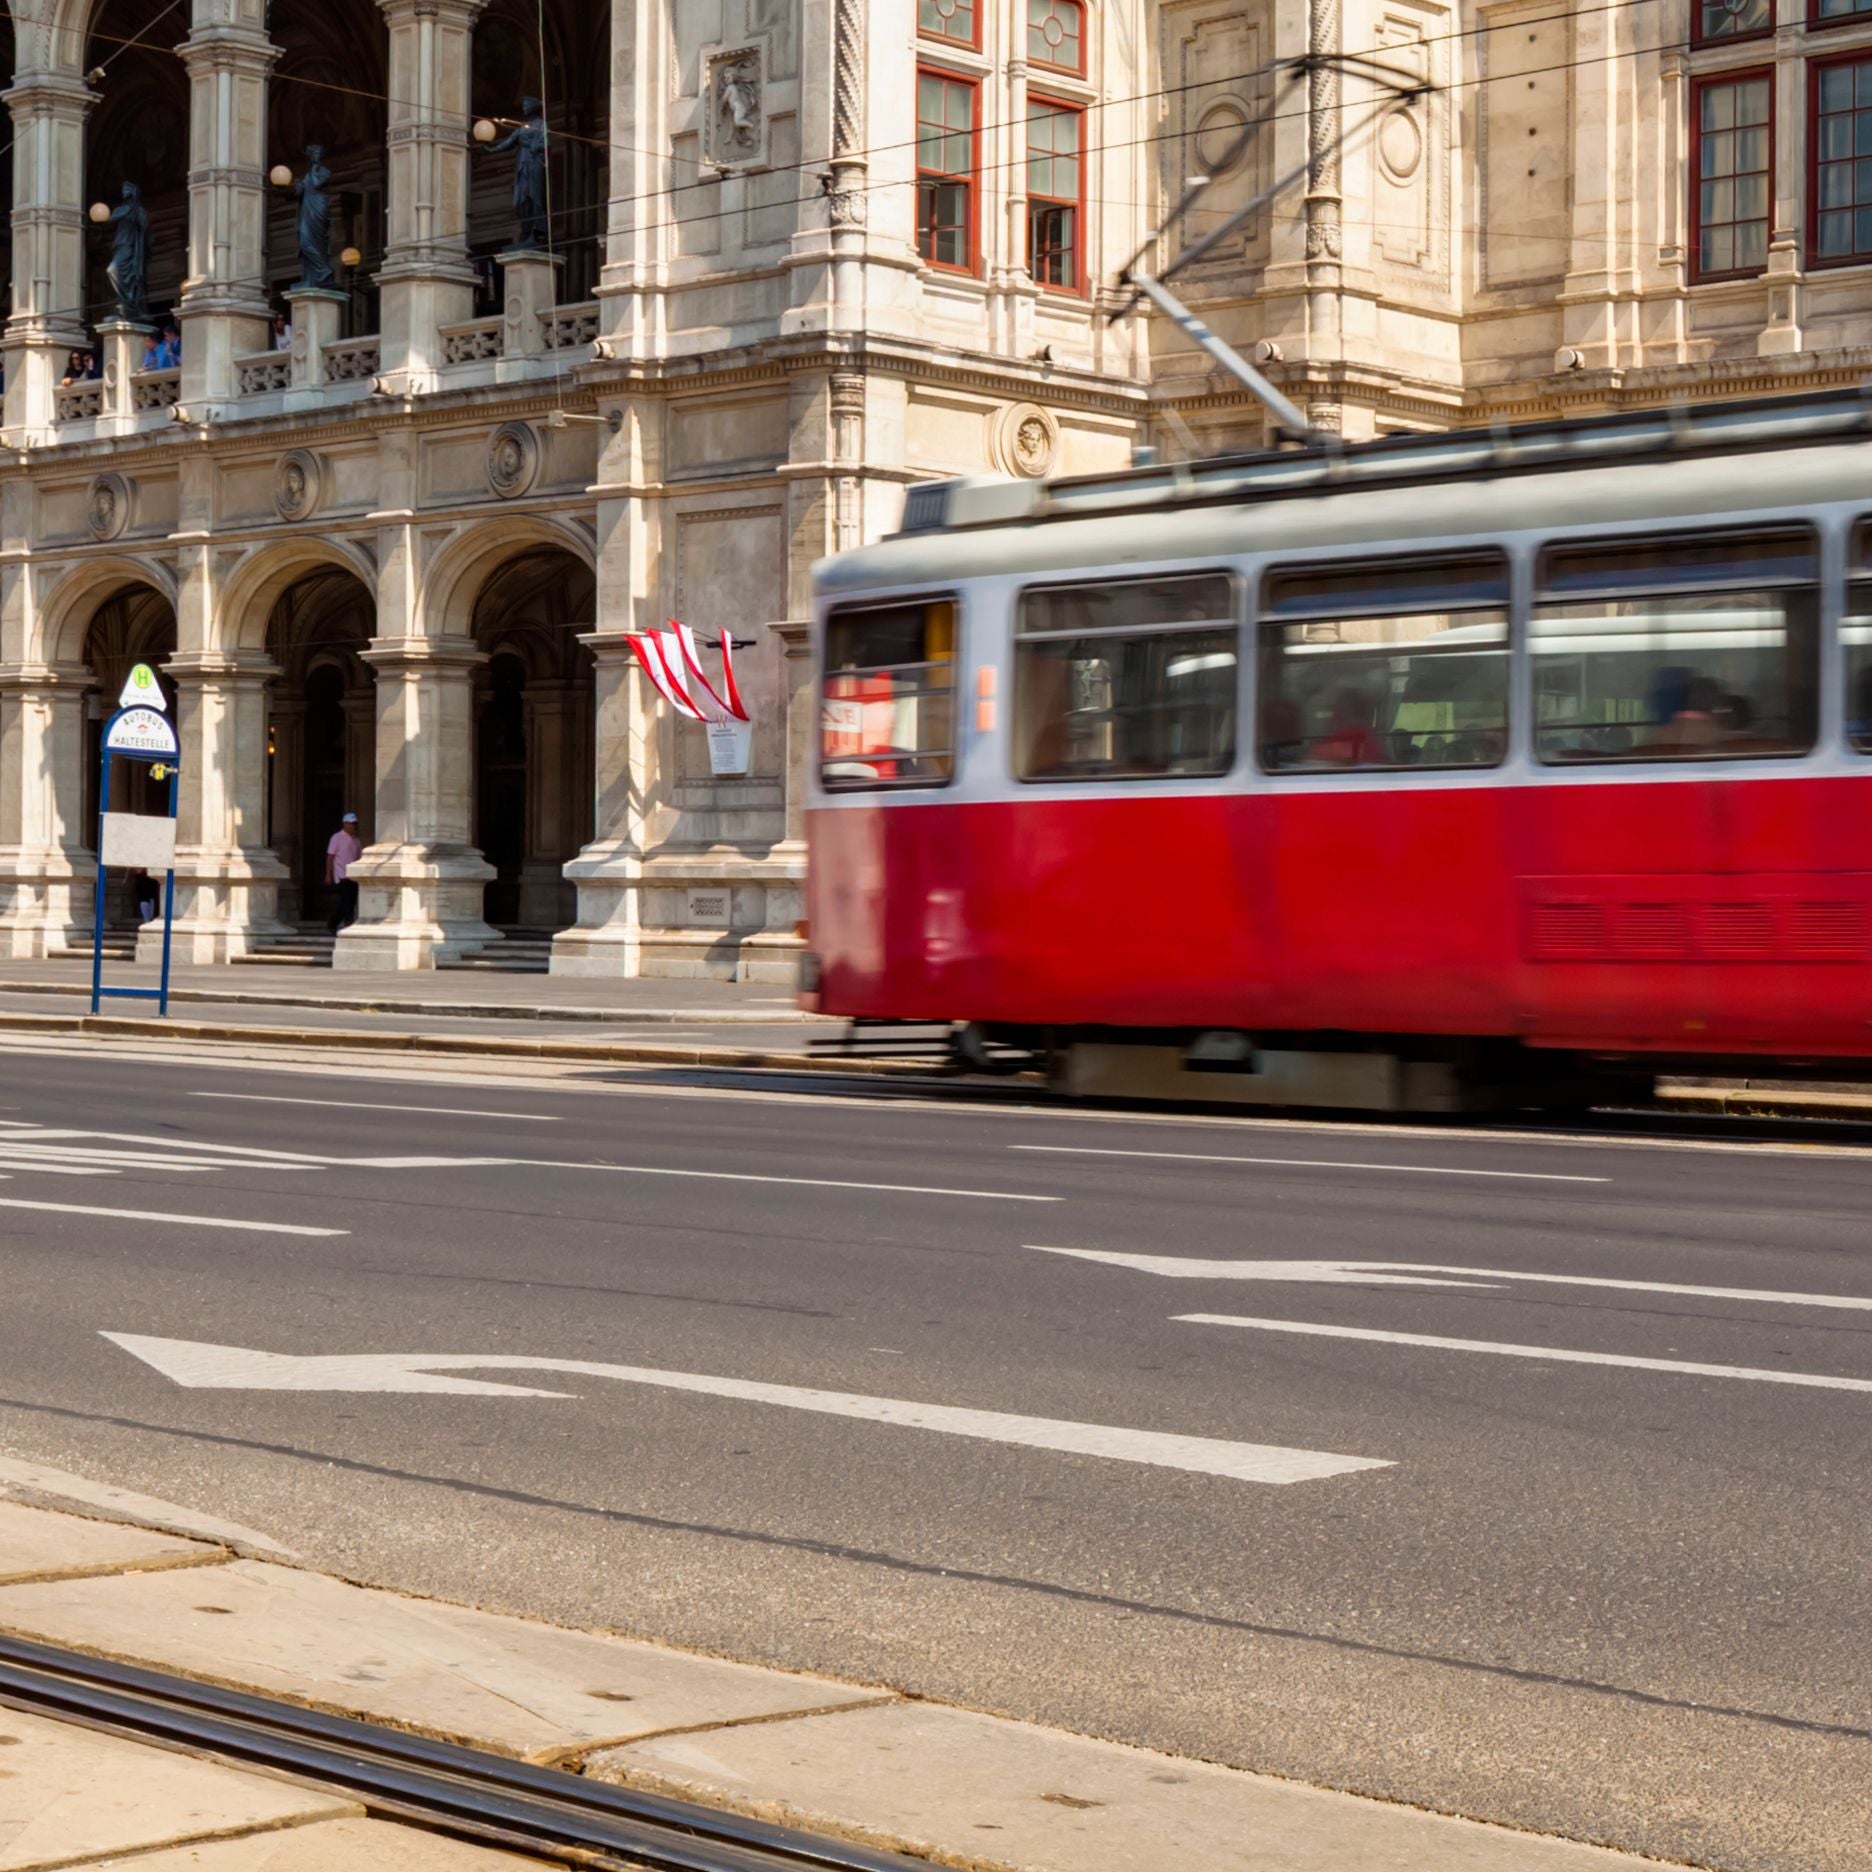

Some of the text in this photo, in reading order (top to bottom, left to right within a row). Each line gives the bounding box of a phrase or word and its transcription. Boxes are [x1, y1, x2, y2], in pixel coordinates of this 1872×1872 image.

[137, 670, 148, 685] H
[123, 711, 165, 730] AUTOBUS
[114, 735, 170, 749] HALTESTELLE
